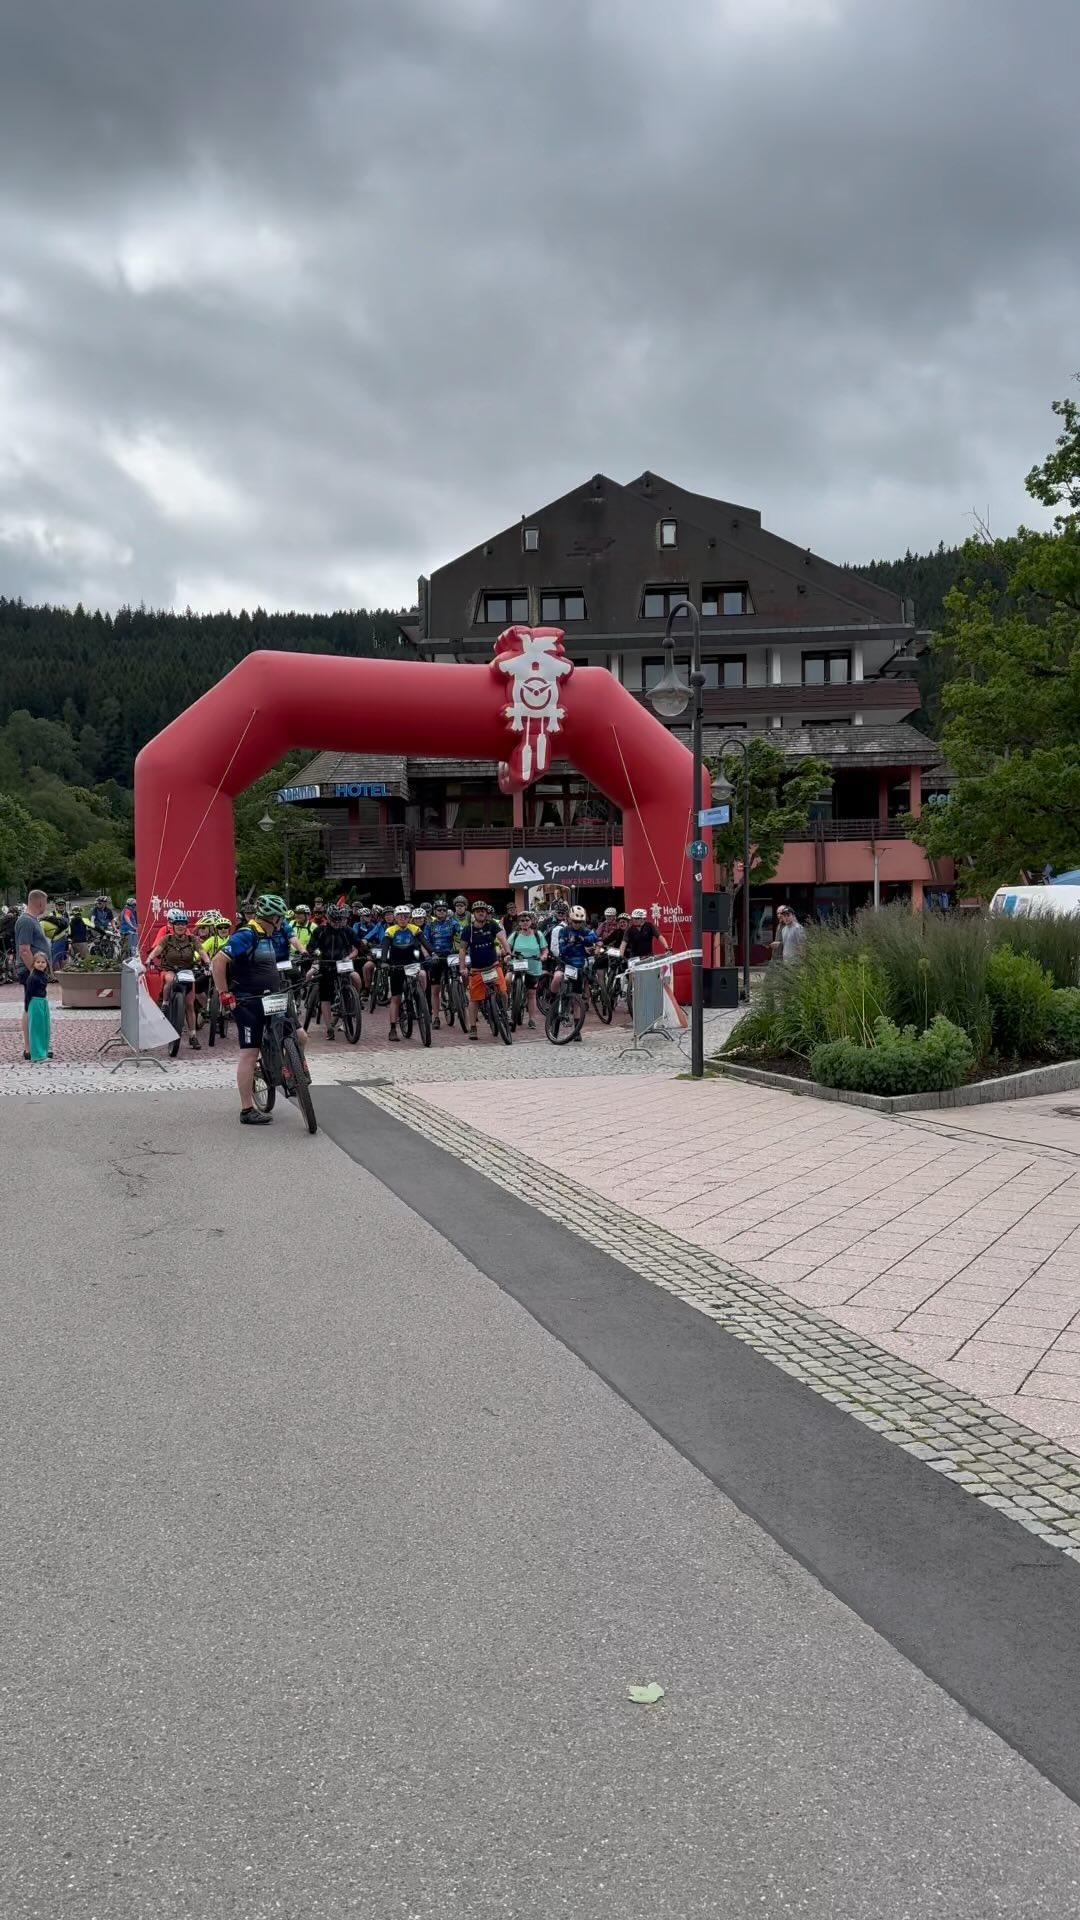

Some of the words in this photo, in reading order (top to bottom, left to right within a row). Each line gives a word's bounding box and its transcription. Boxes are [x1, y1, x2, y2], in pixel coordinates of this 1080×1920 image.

[336, 783, 392, 798] HOTEL
[543, 859, 608, 879] Sportwelt
[163, 899, 185, 908] Hoch
[663, 905, 684, 914] Hoch
[663, 915, 692, 923] schwar
